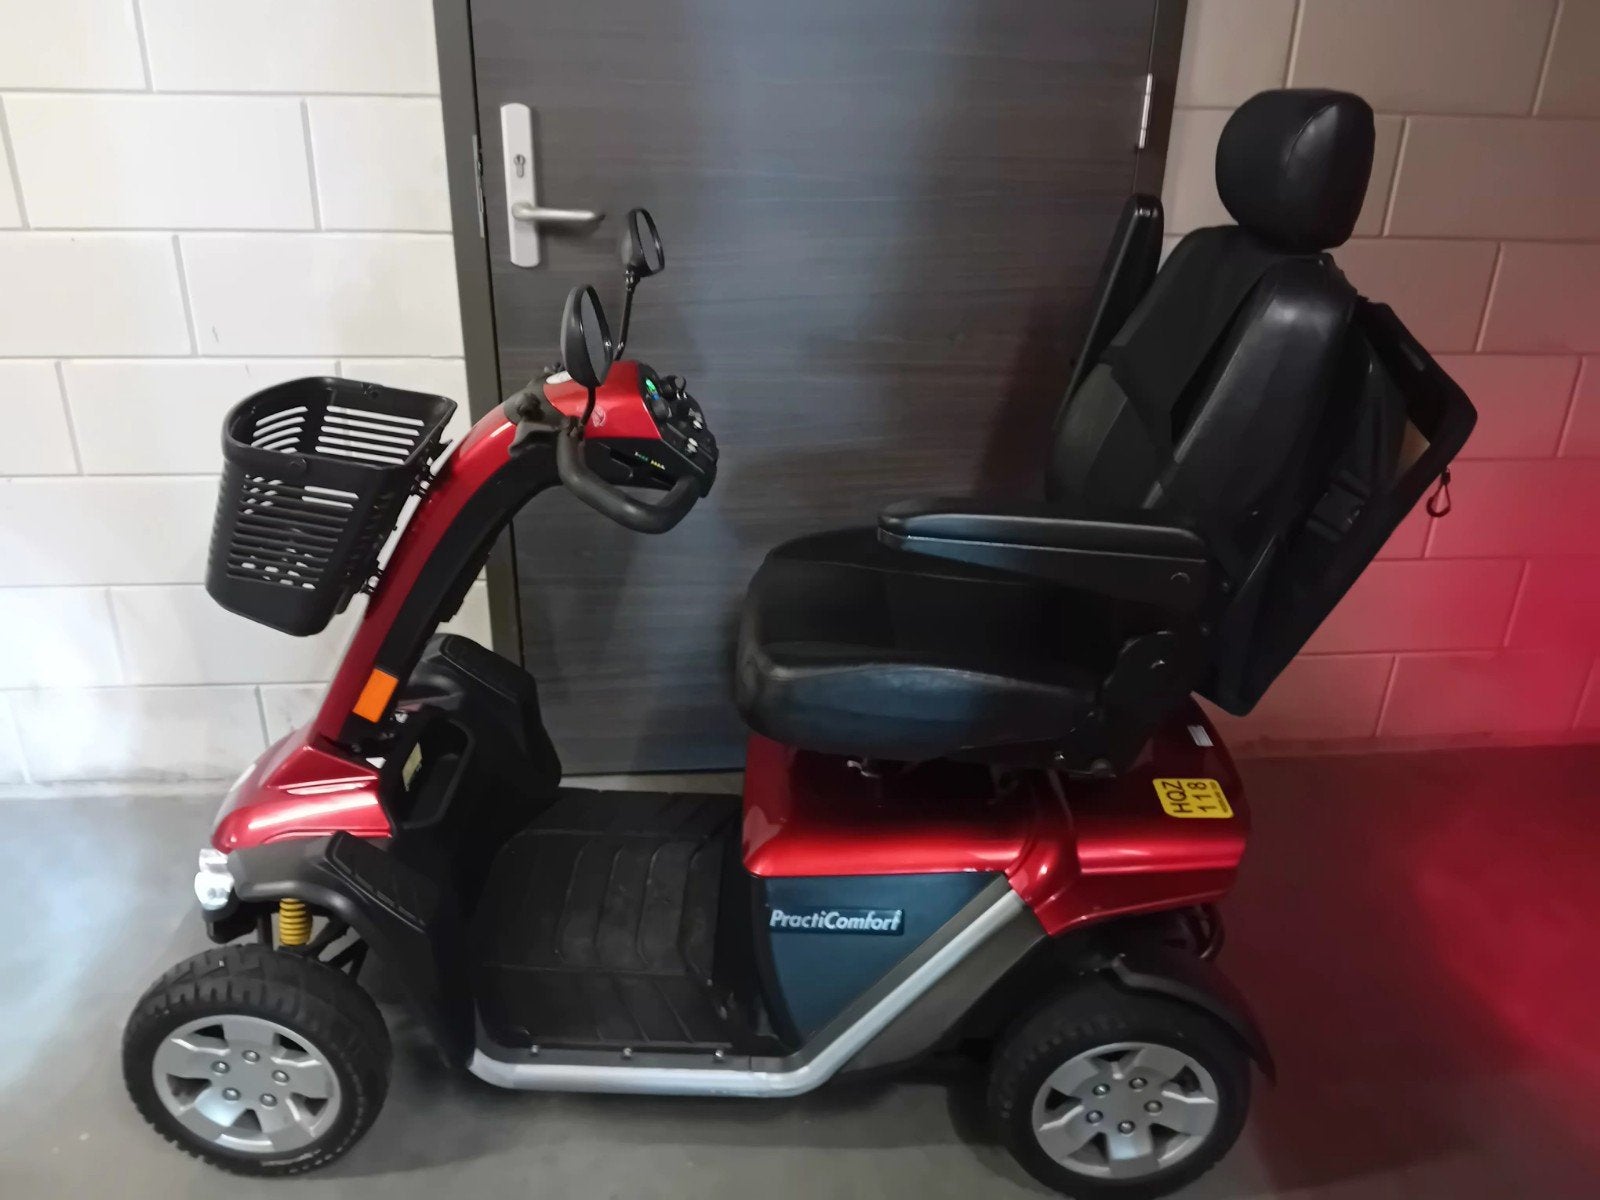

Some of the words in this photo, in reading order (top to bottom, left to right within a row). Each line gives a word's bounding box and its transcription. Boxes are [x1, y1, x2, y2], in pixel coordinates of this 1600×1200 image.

[1161, 780, 1193, 813] HQZ
[1186, 782, 1217, 812] 118
[769, 909, 902, 931] PractiComfort
